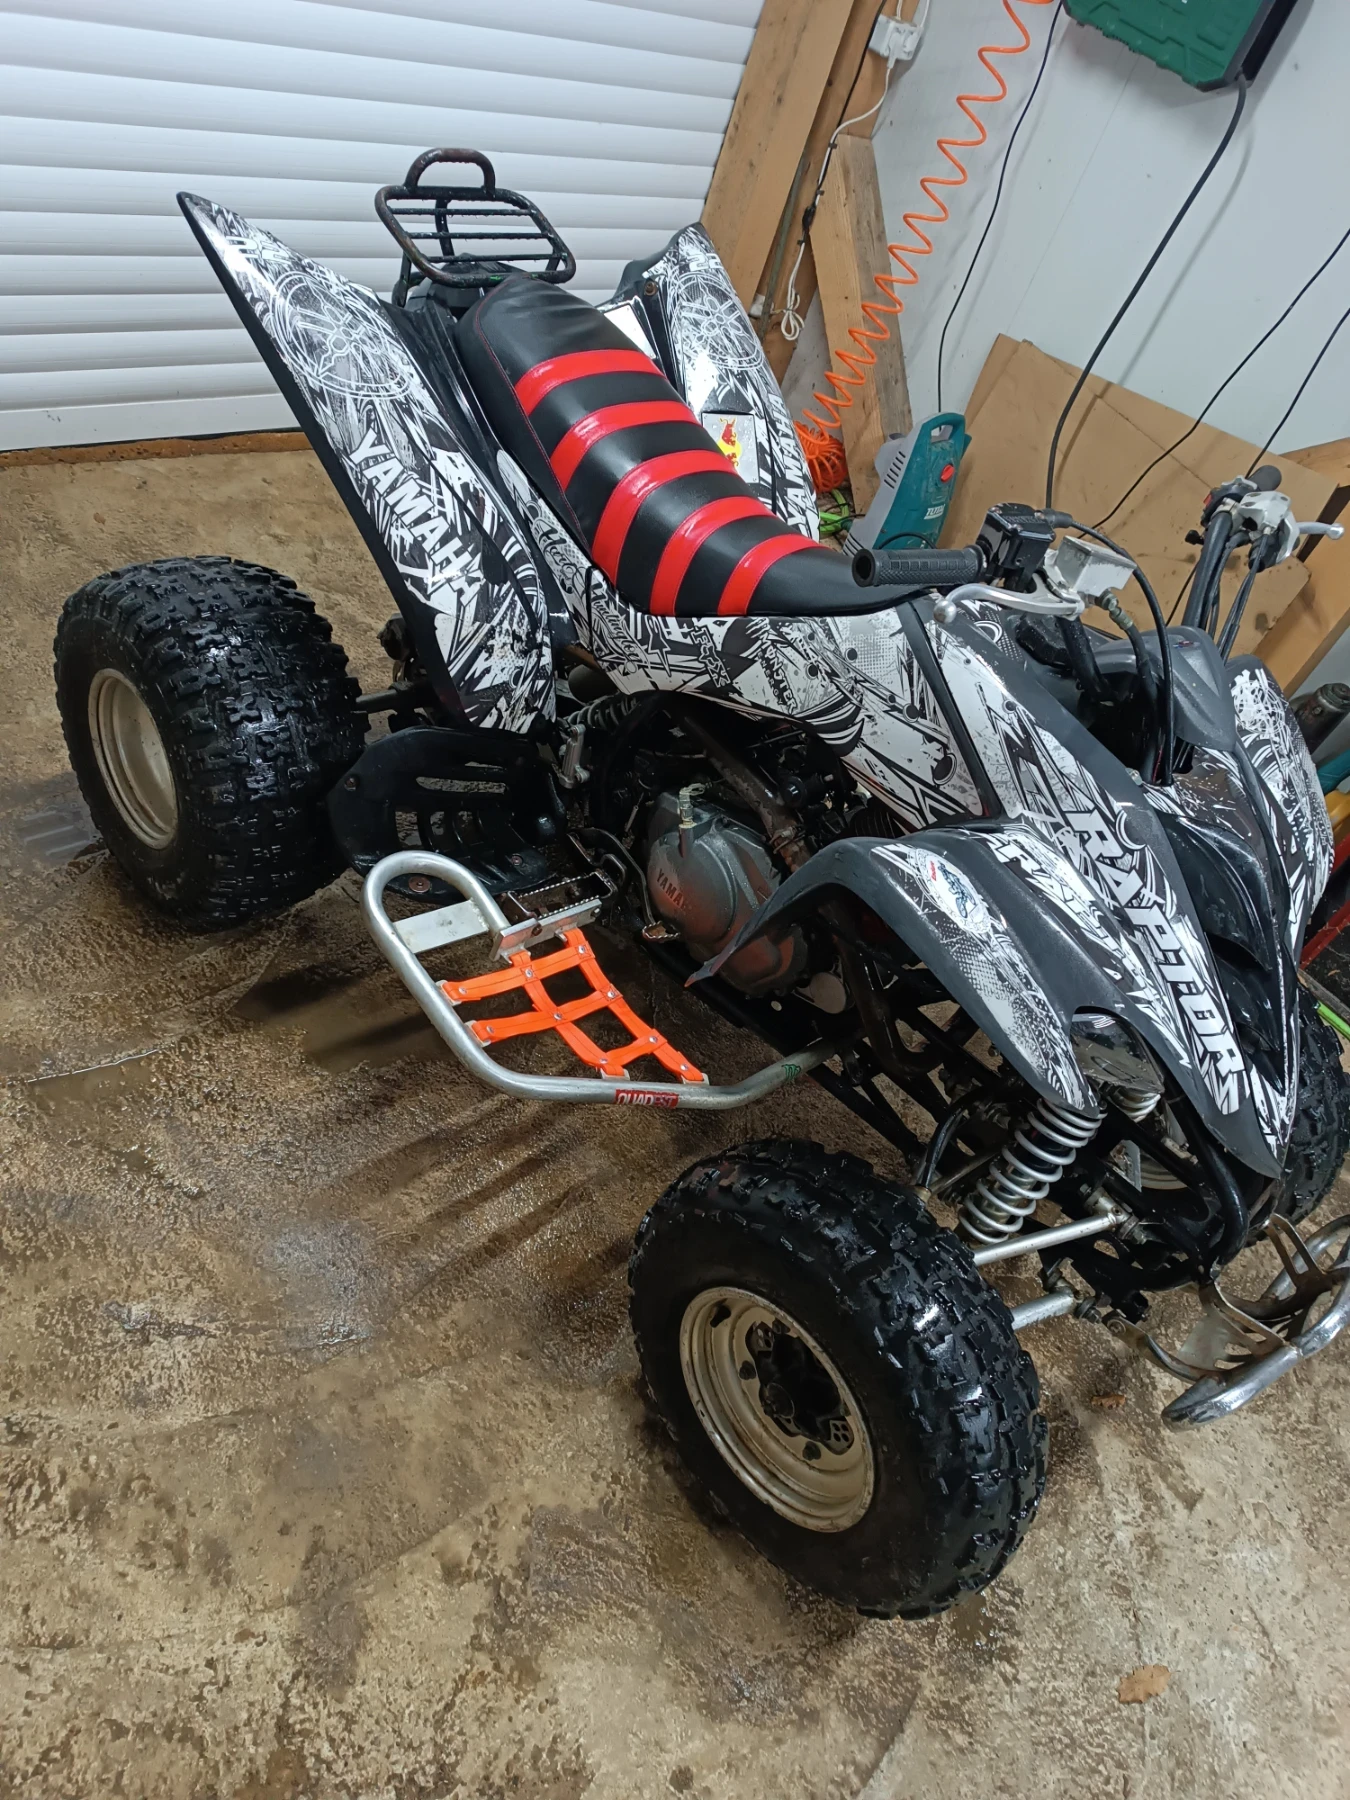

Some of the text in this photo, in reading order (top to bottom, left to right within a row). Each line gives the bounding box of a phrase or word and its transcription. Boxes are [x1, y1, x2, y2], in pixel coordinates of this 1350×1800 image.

[767, 393, 806, 526] YAMAHA
[349, 427, 482, 607] YAMAHA
[690, 626, 731, 688] FOX
[757, 650, 783, 706] ENERGY
[761, 632, 798, 715] MONSTER
[656, 867, 684, 909] YAMA
[1065, 808, 1245, 1078] RAPTOR
